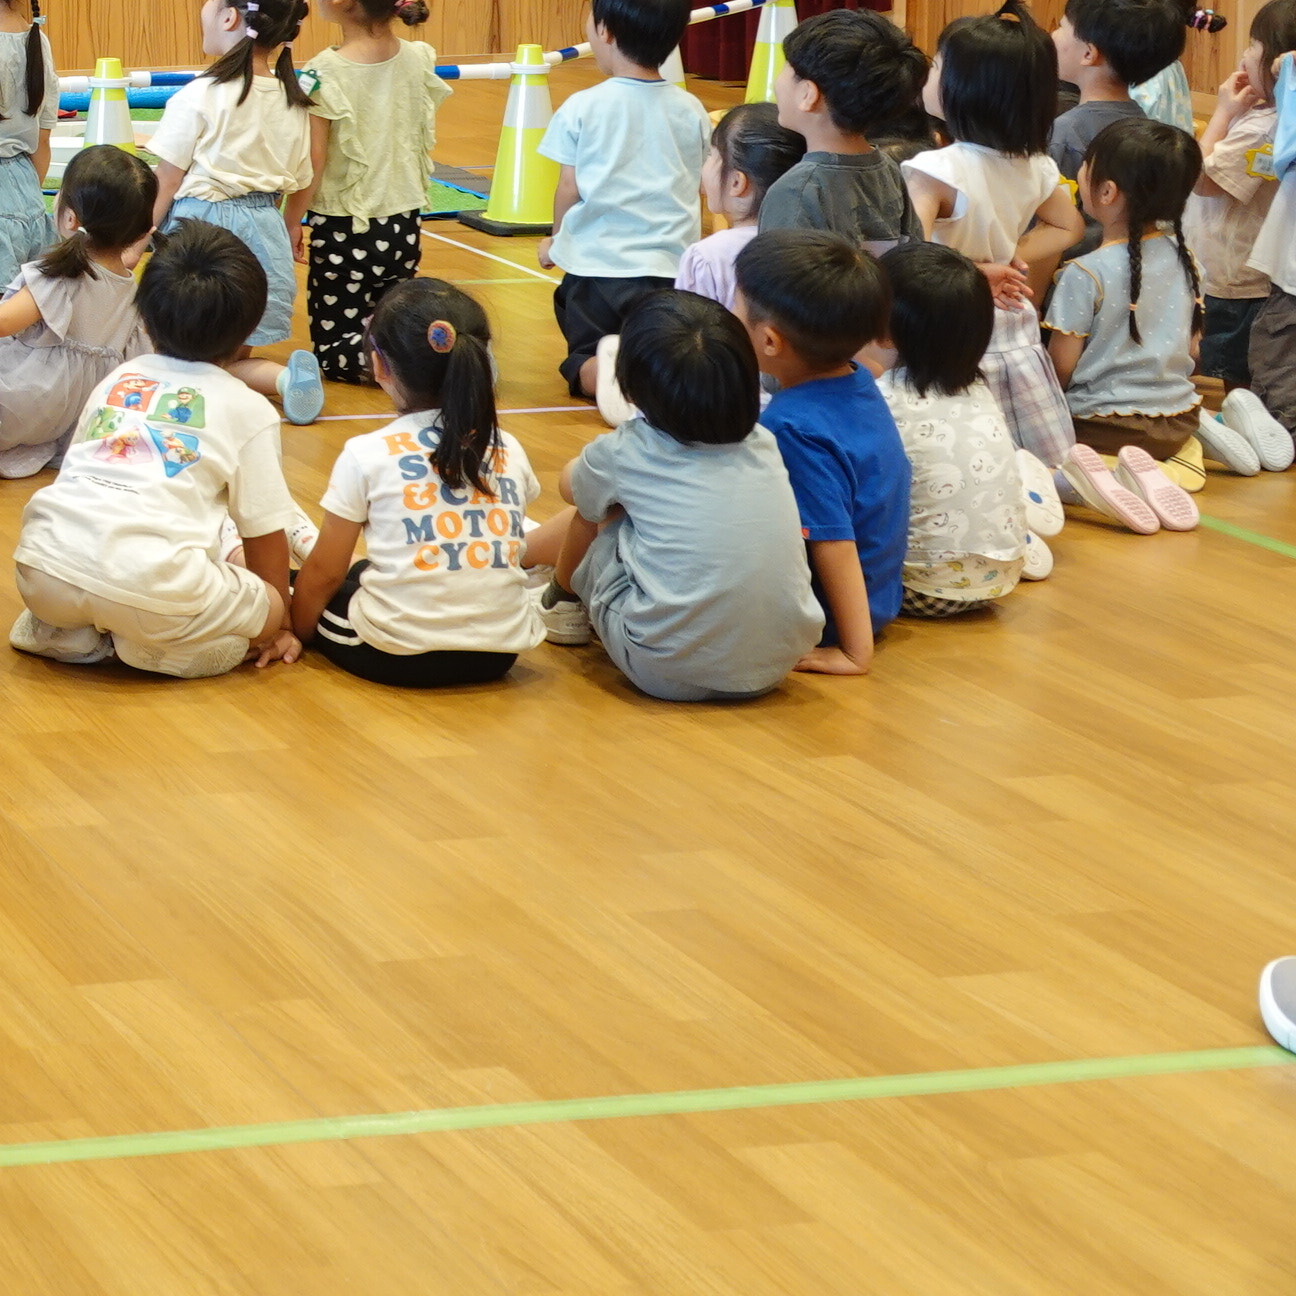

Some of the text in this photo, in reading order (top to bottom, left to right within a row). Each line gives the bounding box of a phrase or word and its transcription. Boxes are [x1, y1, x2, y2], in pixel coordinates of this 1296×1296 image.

[403, 476, 521, 511] & CAR
[402, 508, 525, 545] MOTOR
[413, 540, 522, 572] CYCLE
